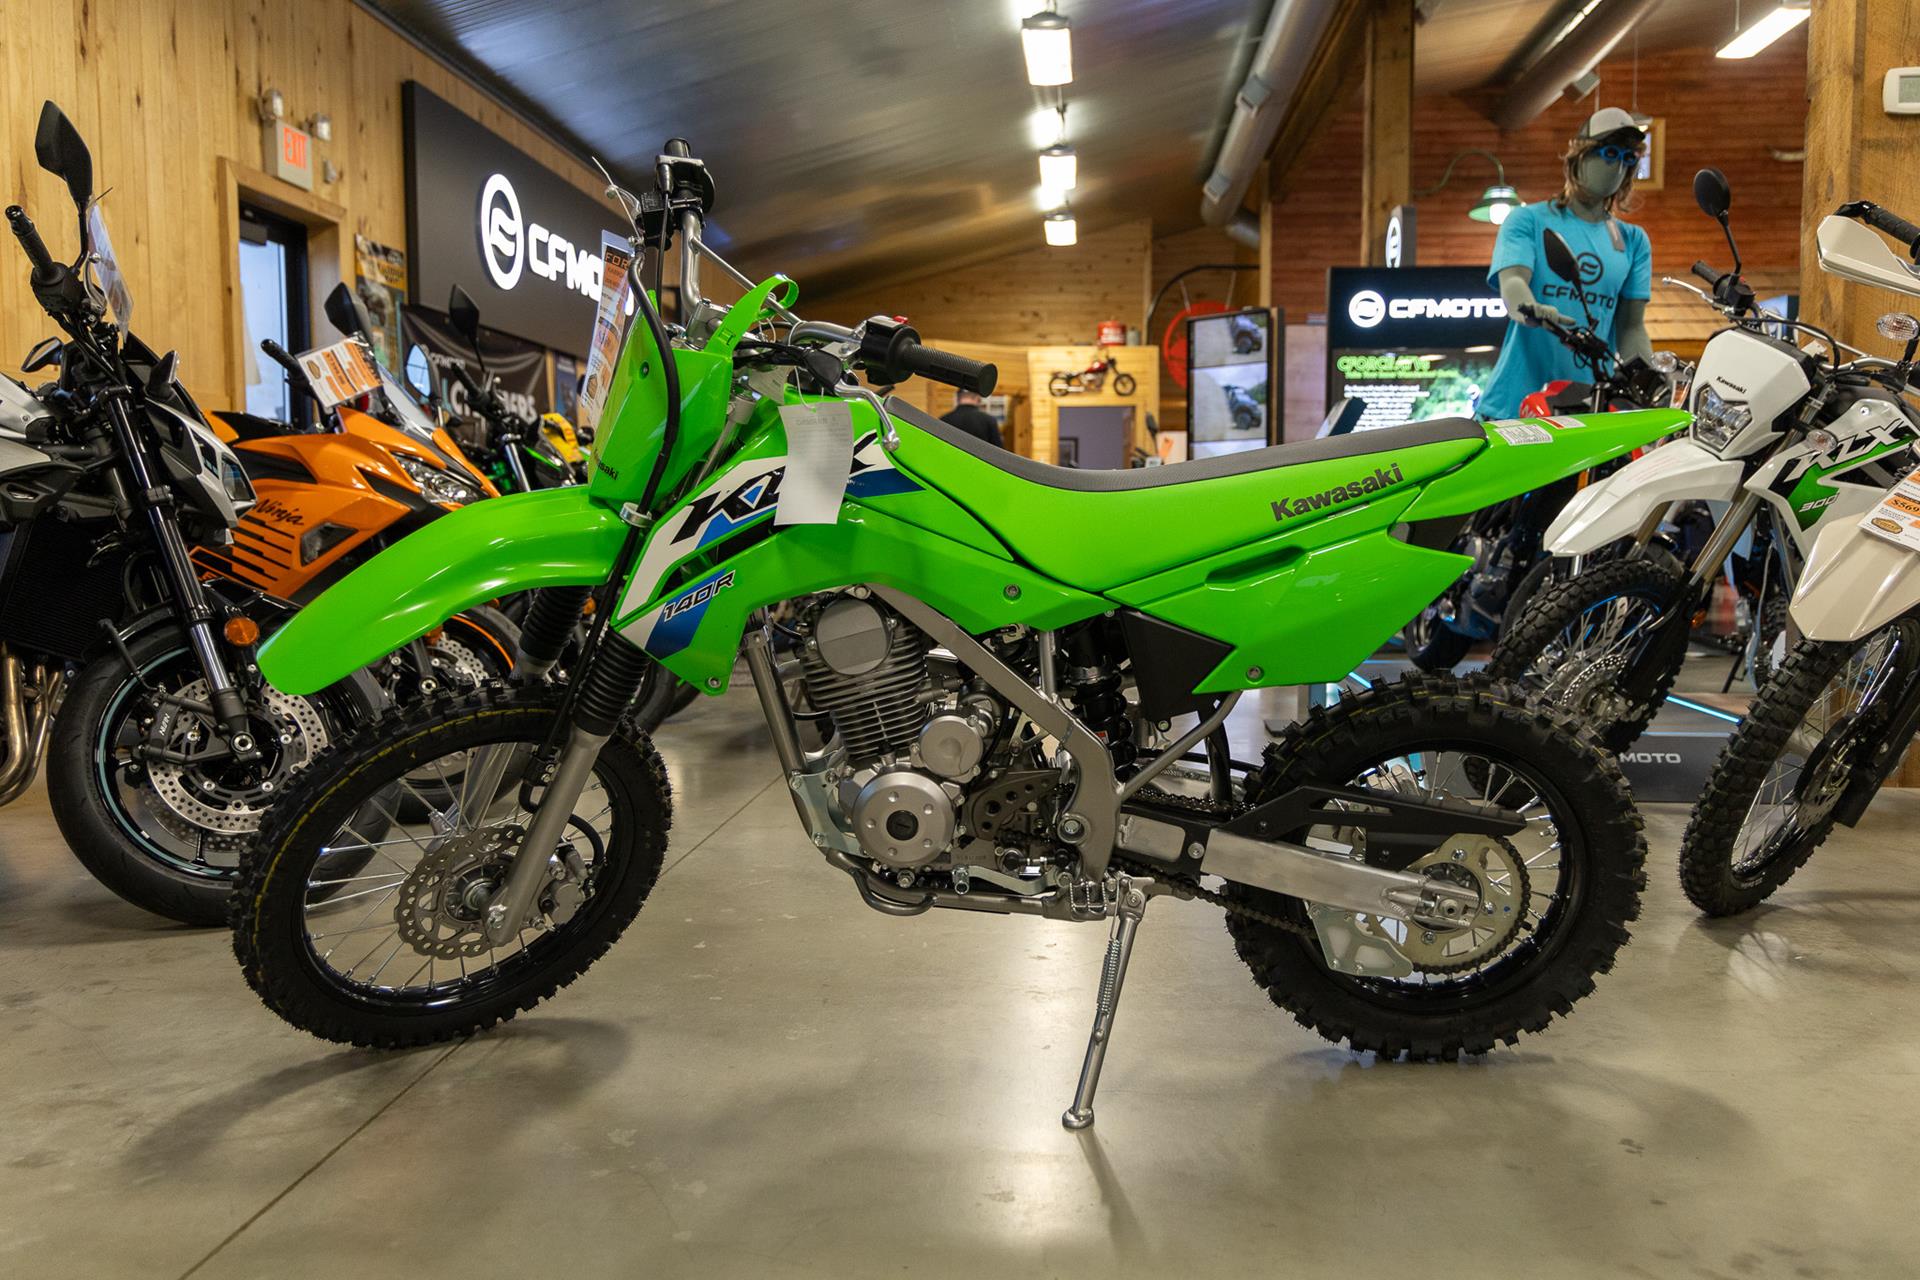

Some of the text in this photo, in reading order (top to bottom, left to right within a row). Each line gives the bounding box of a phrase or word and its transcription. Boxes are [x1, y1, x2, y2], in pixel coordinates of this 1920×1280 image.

[283, 127, 308, 170] EXIT
[1388, 298, 1509, 319] CFMOTO
[1542, 284, 1616, 310] CFMOTO
[1716, 376, 1747, 394] Kawasaki
[1783, 418, 1905, 483] KLX
[1270, 462, 1404, 522] Kawasaki
[1799, 492, 1841, 513] 300
[256, 499, 304, 526] Ninja
[663, 569, 736, 622] 140R
[1618, 752, 1682, 764] MOTO
